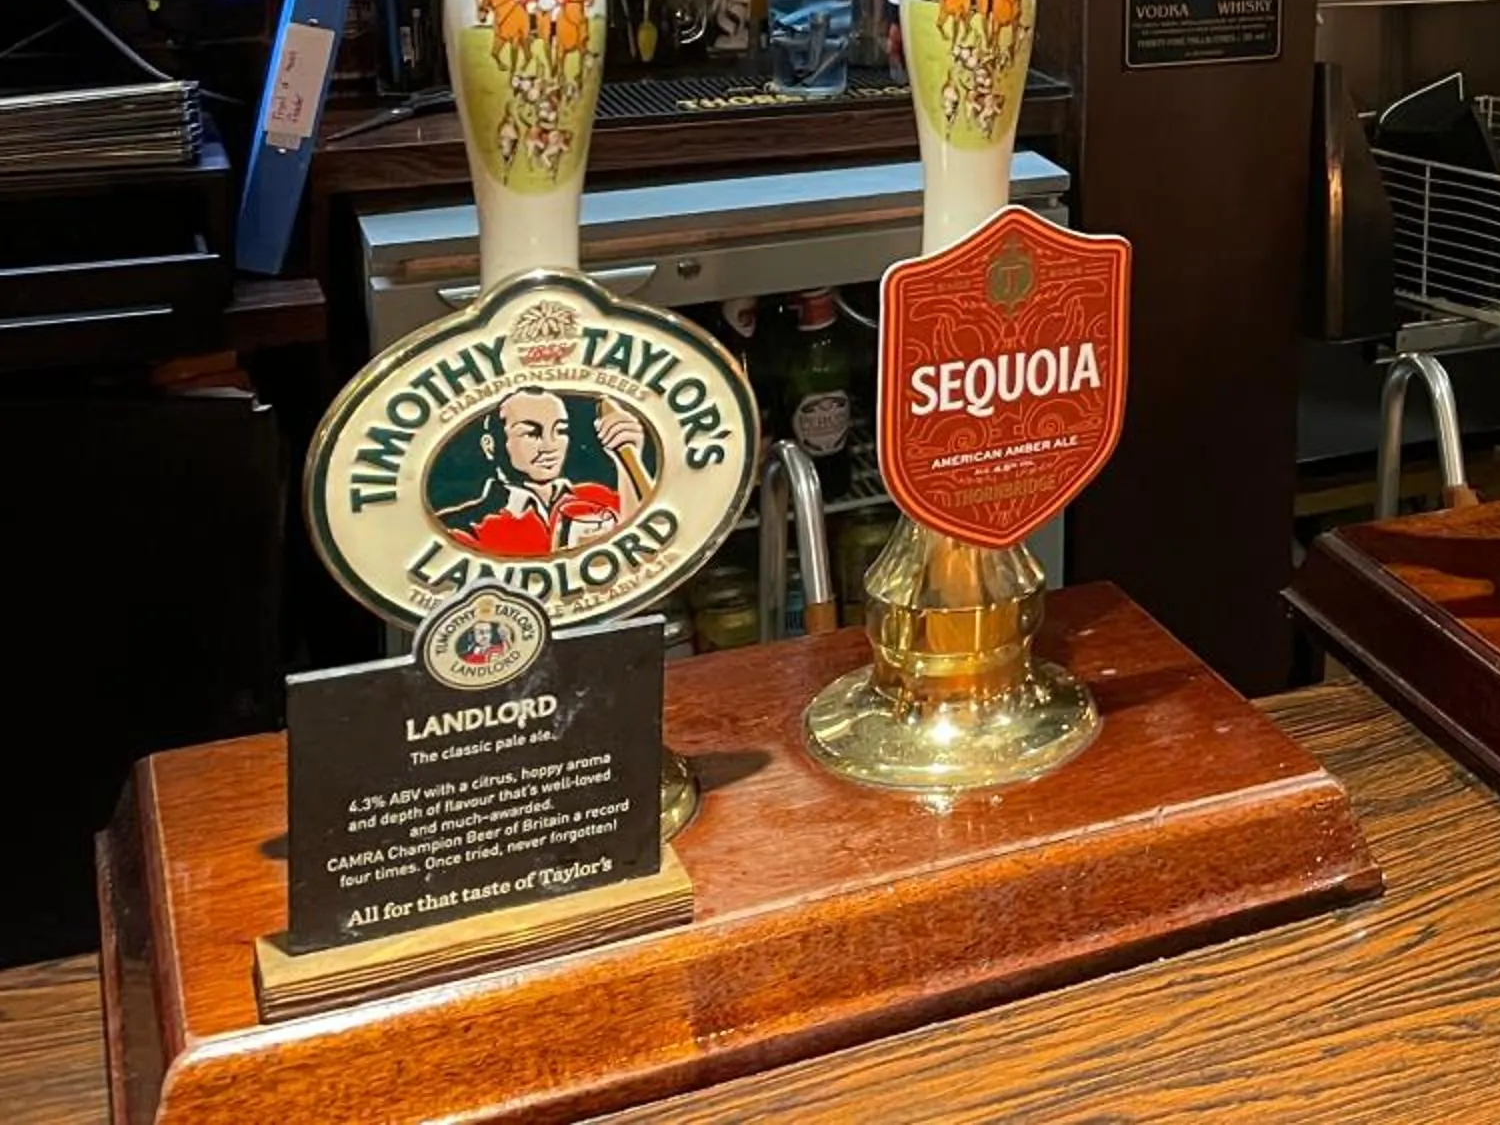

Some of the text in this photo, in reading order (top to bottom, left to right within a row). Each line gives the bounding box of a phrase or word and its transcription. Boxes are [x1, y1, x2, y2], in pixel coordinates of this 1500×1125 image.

[1136, 0, 1273, 19] VODKA WHISKY
[439, 367, 649, 424] CHAMPIONSHIP BEERS
[910, 342, 1101, 418] SEQUOIA
[351, 326, 735, 514] TIMOTHY TAYLOR'S
[931, 435, 1079, 470] AMERICAN AMBER ALE
[954, 475, 1057, 507] THORNBRIDGE
[407, 508, 679, 600] LANDLORD
[435, 604, 536, 655] TIMOTHY TAYLOR'S
[450, 649, 522, 677] LANDLORD
[405, 694, 558, 742] LANDLORD
[410, 748, 439, 766] The
[441, 741, 492, 761] classic
[495, 734, 526, 754] pale
[348, 753, 612, 813] 4.3% ABV with a citrus, hoppy aroma
[348, 768, 612, 832] and depth of flavour that's well-loved
[326, 797, 631, 873] CAMRA Champion Beer of Britain a record
[409, 798, 555, 838] and much-awarded.
[339, 817, 618, 889] four times. Once tried, never forgotten!
[348, 855, 613, 929] All for that taste of Taylor's
